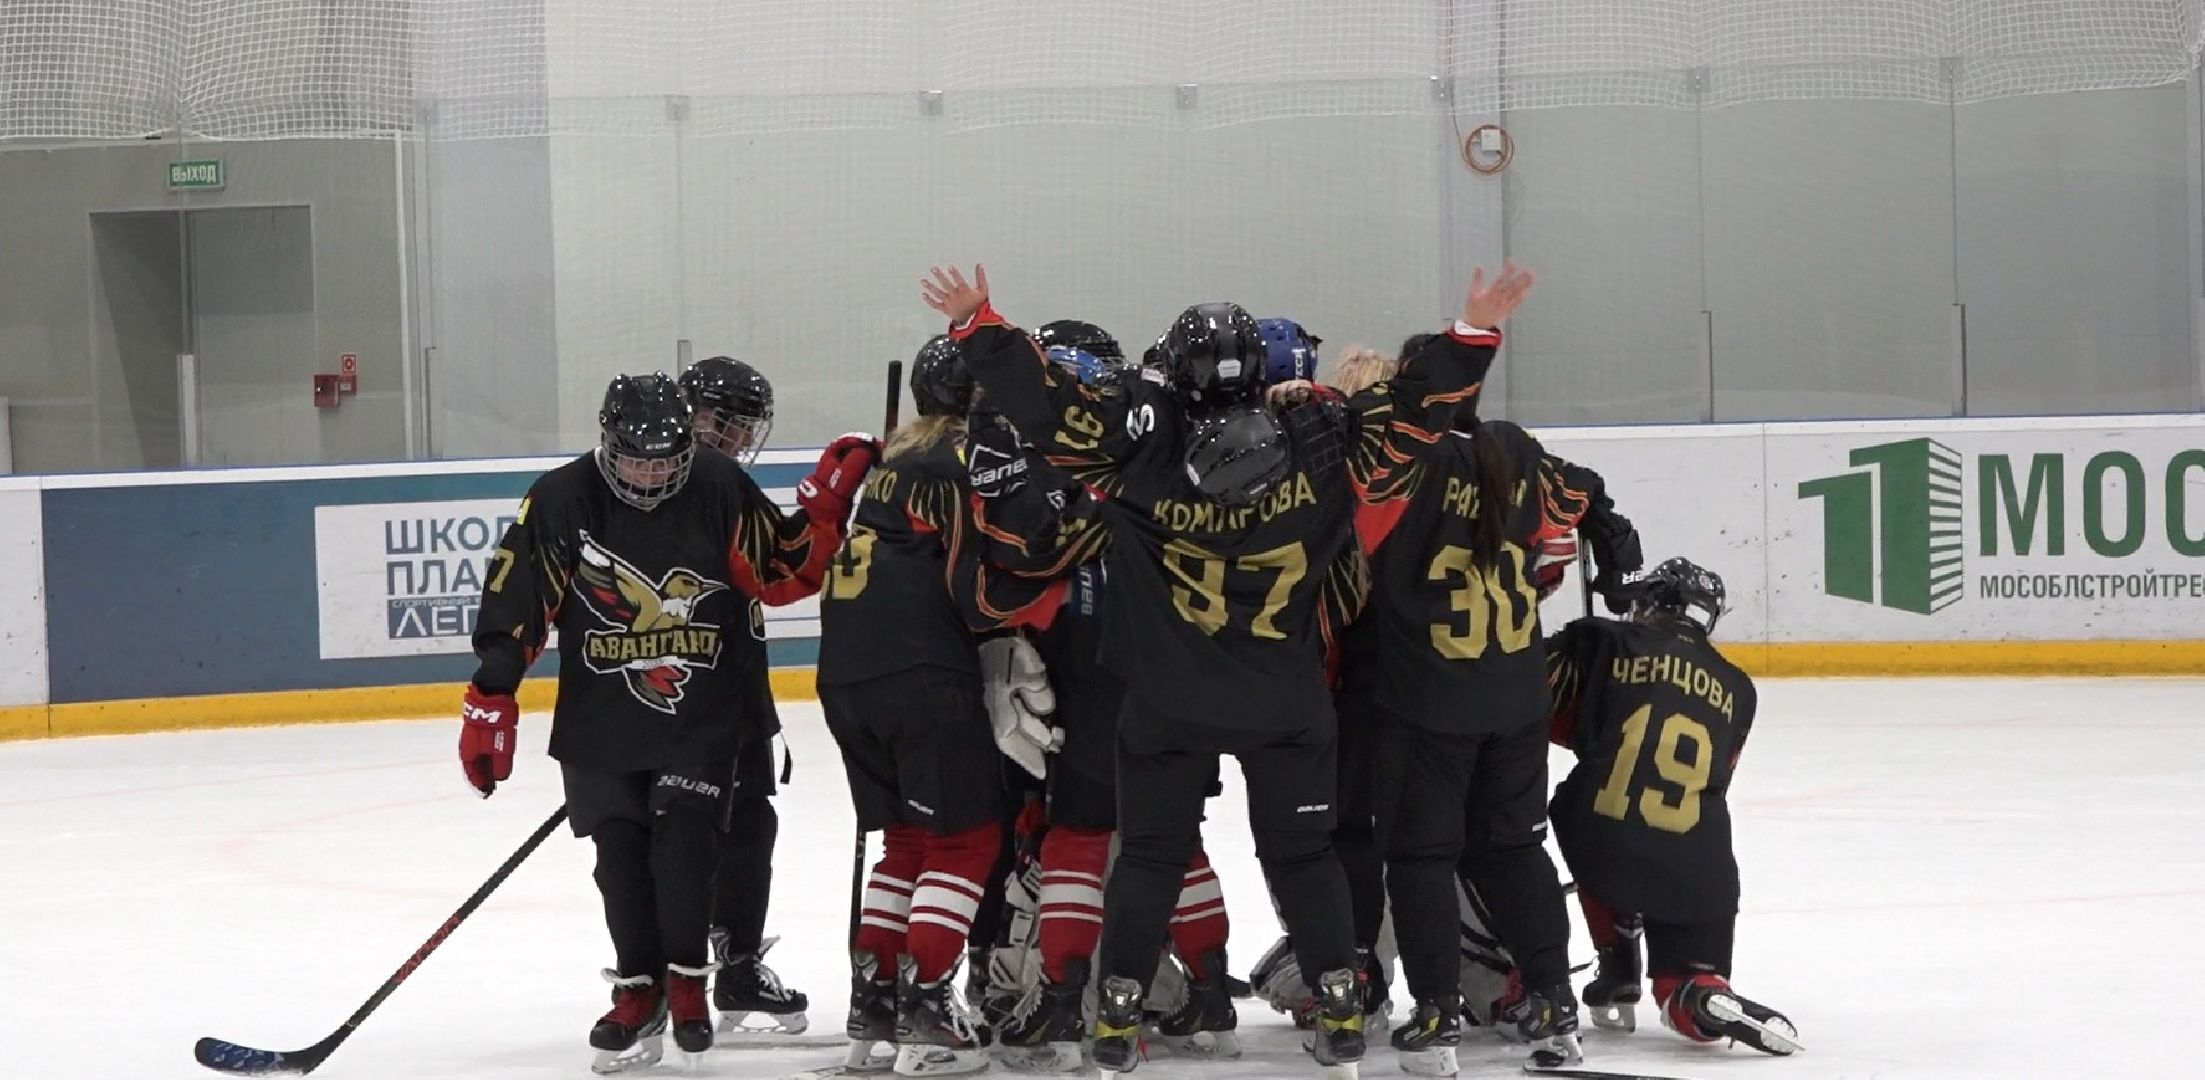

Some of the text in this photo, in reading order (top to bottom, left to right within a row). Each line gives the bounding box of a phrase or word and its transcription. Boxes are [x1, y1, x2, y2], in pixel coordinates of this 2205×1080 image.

[171, 164, 217, 183] ВЫХОД
[1977, 449, 2205, 557] МОС
[386, 558, 495, 596] ПЛА
[1163, 538, 1308, 638] 97
[1428, 540, 1538, 660] 30
[1980, 568, 2205, 598] МОСОБЛСТРОЙТРЕ
[1612, 653, 1734, 722] ЧЕНЦОВА
[1593, 703, 1713, 834] 19
